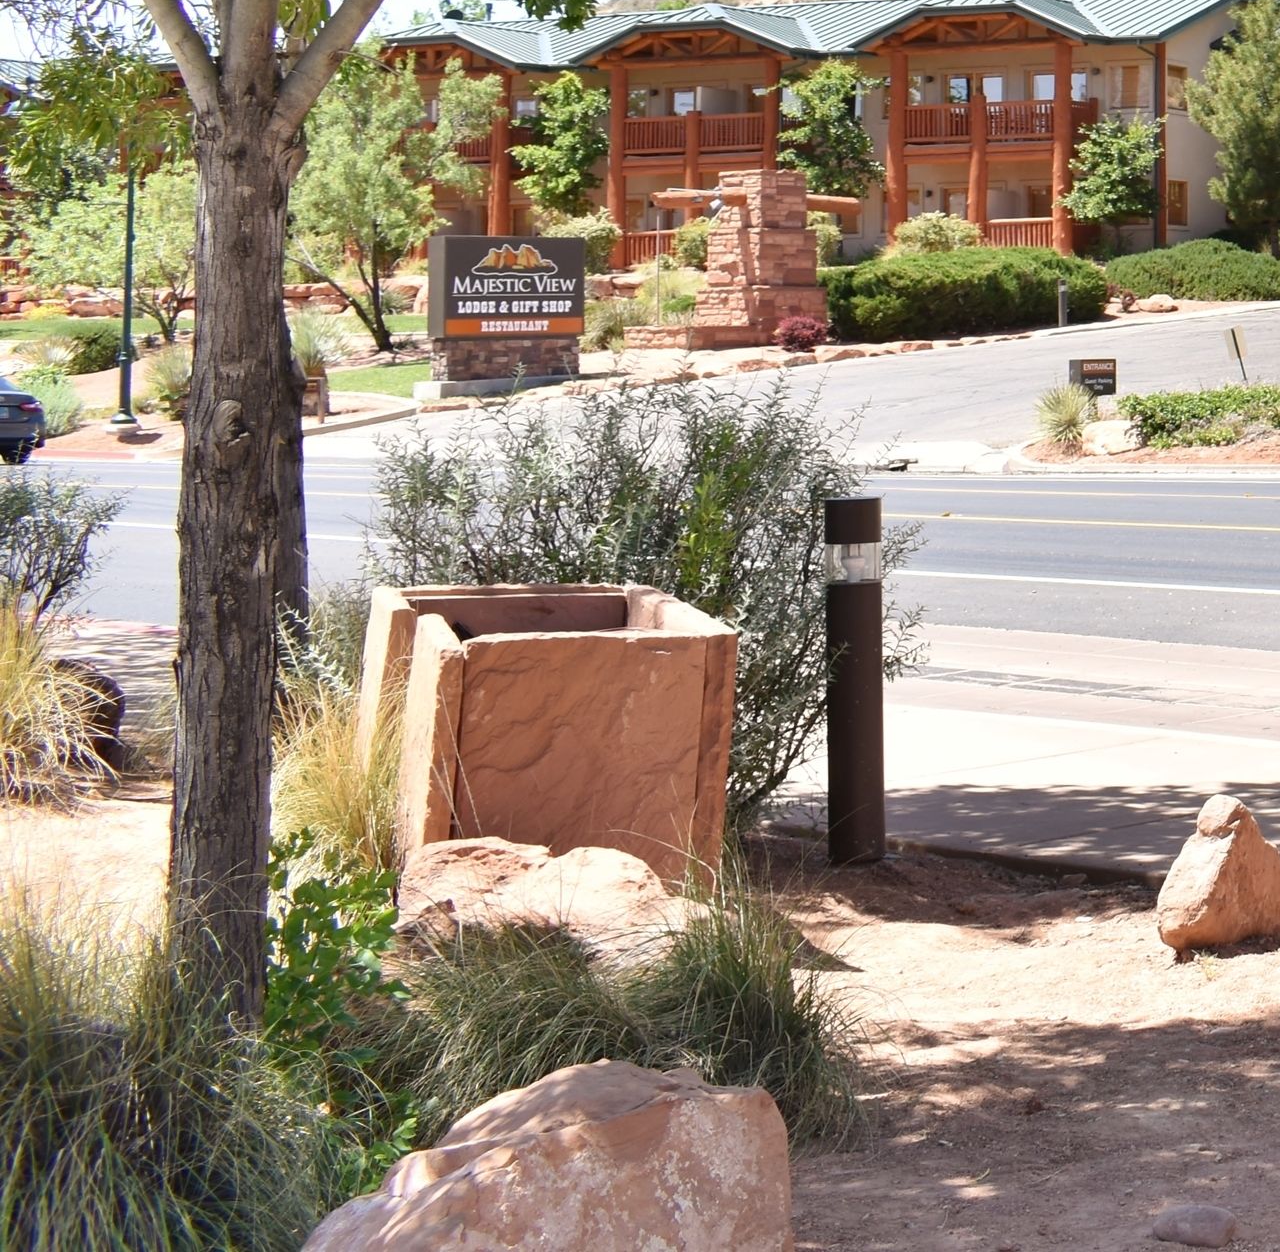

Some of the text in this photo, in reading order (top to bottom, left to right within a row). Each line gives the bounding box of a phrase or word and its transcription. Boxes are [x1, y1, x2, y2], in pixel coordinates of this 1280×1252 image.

[452, 275, 576, 296] MAJESTIC VIEW
[457, 300, 572, 313] LODGE & GIFT SHOP
[481, 320, 549, 332] RESTAURANT
[1083, 363, 1114, 371] ENTRANCE
